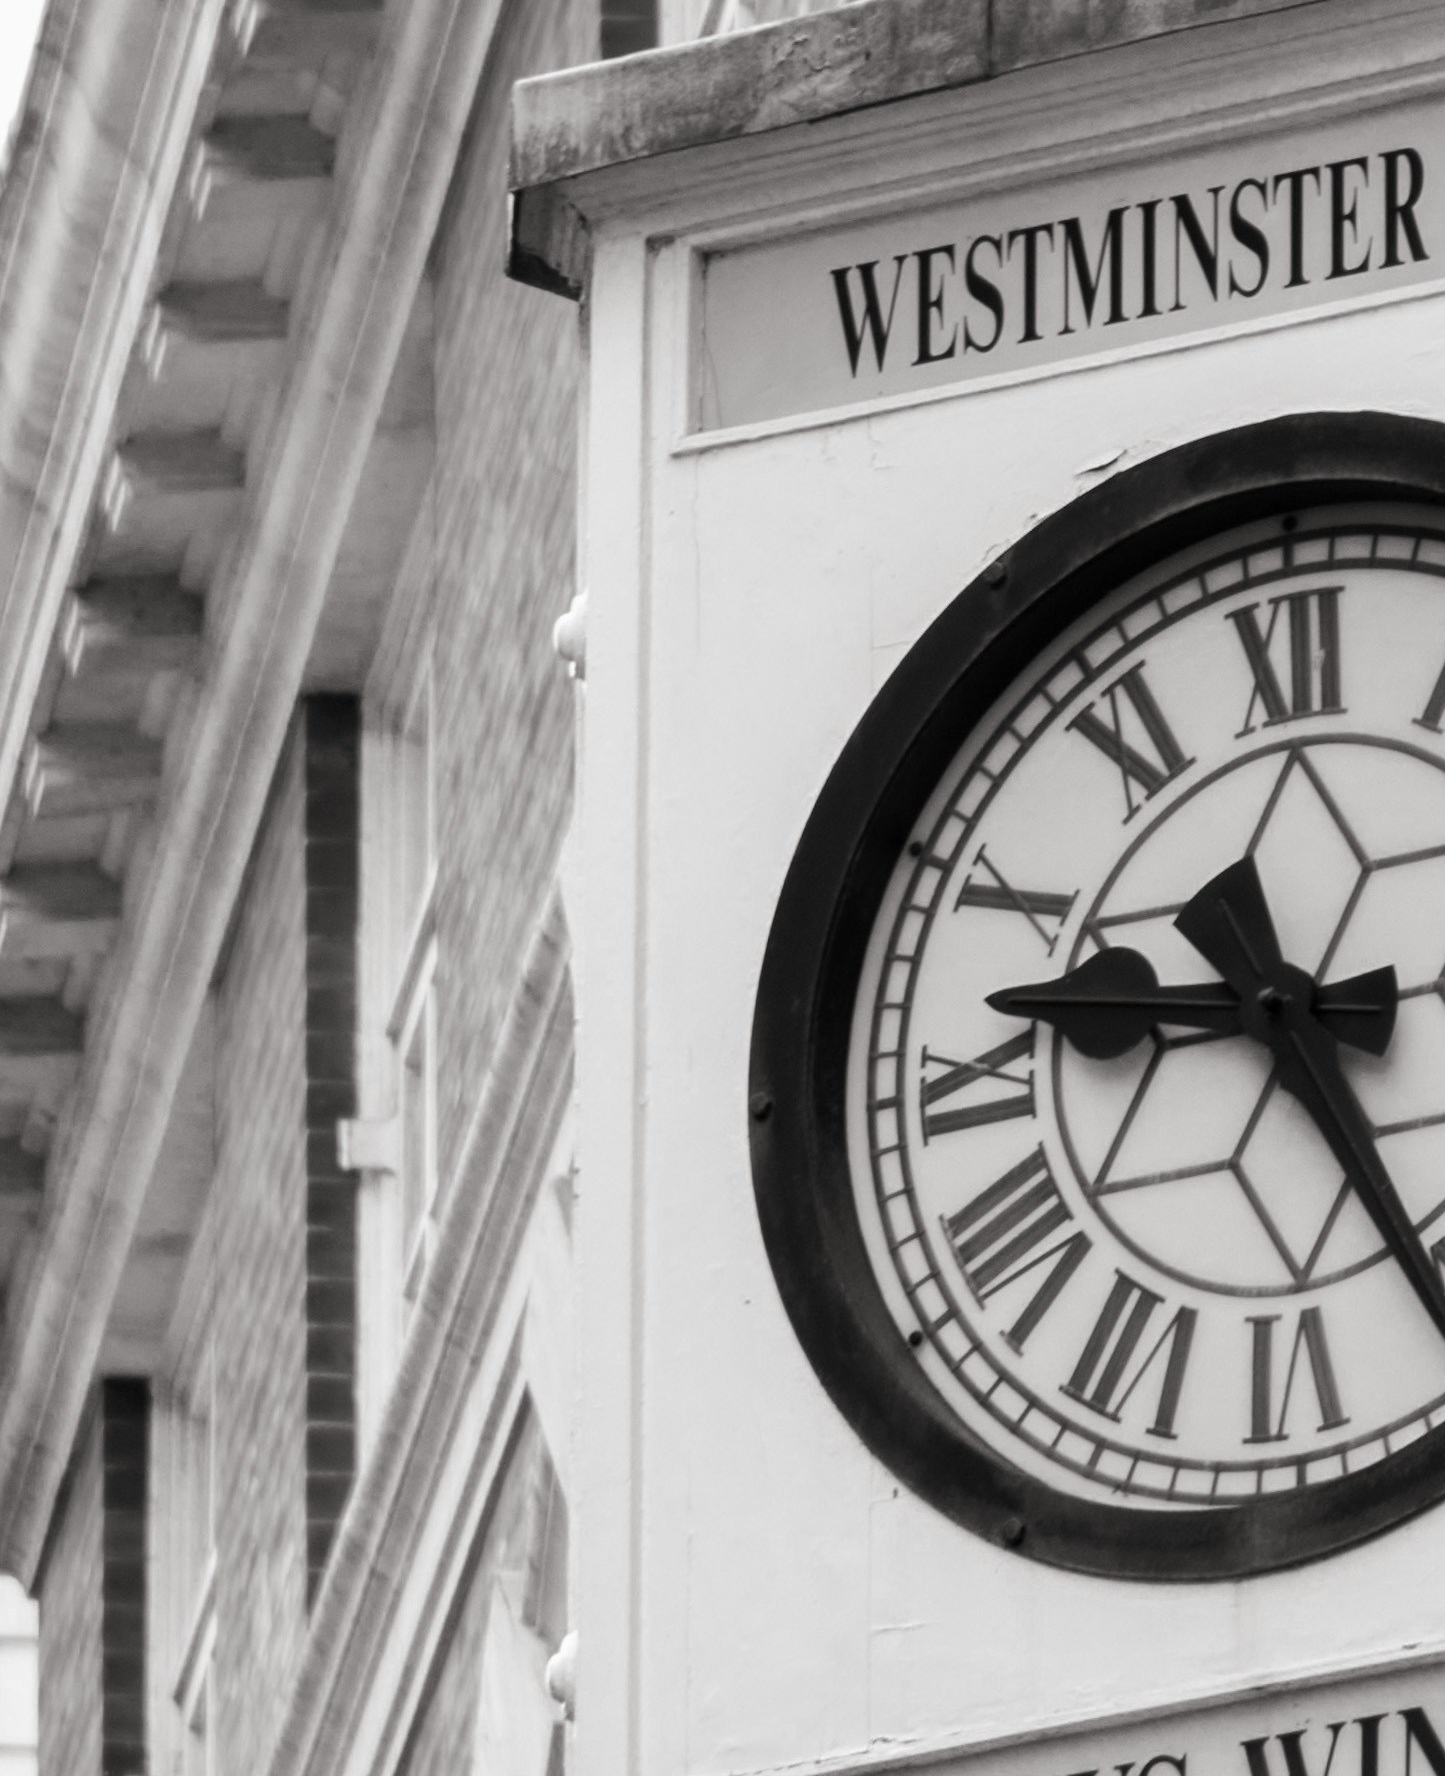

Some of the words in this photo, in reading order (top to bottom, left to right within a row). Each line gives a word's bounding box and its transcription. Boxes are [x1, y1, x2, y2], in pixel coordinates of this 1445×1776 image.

[830, 148, 1428, 377] WESTMINSTER
[1225, 587, 1348, 739] XII
[1066, 661, 1196, 825] XI
[953, 843, 1080, 958] X
[919, 1017, 1041, 1147] IX
[1058, 1268, 1198, 1440] VII
[1242, 1306, 1351, 1444] VI
